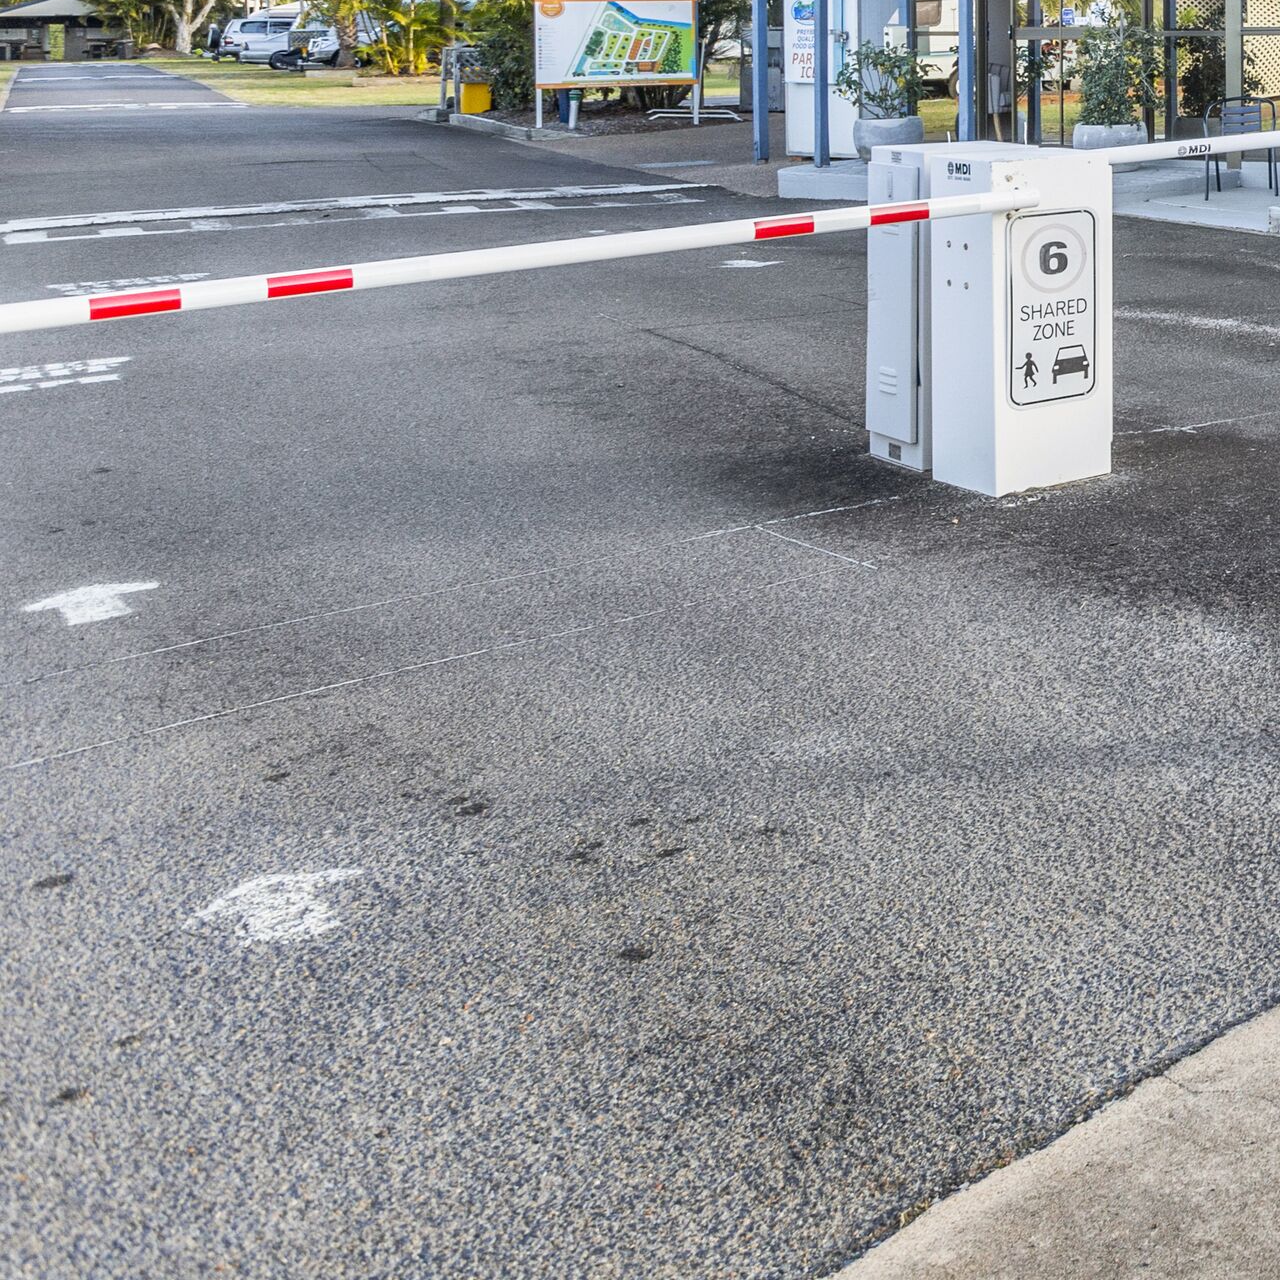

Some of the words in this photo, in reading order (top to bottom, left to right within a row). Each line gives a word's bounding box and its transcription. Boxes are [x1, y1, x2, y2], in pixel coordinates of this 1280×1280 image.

[792, 53, 813, 65] PAR
[1188, 143, 1212, 155] MDI
[954, 162, 971, 176] MDI
[1039, 241, 1068, 275] 6
[1020, 297, 1088, 322] SHARED
[1032, 320, 1075, 341] ZONE
